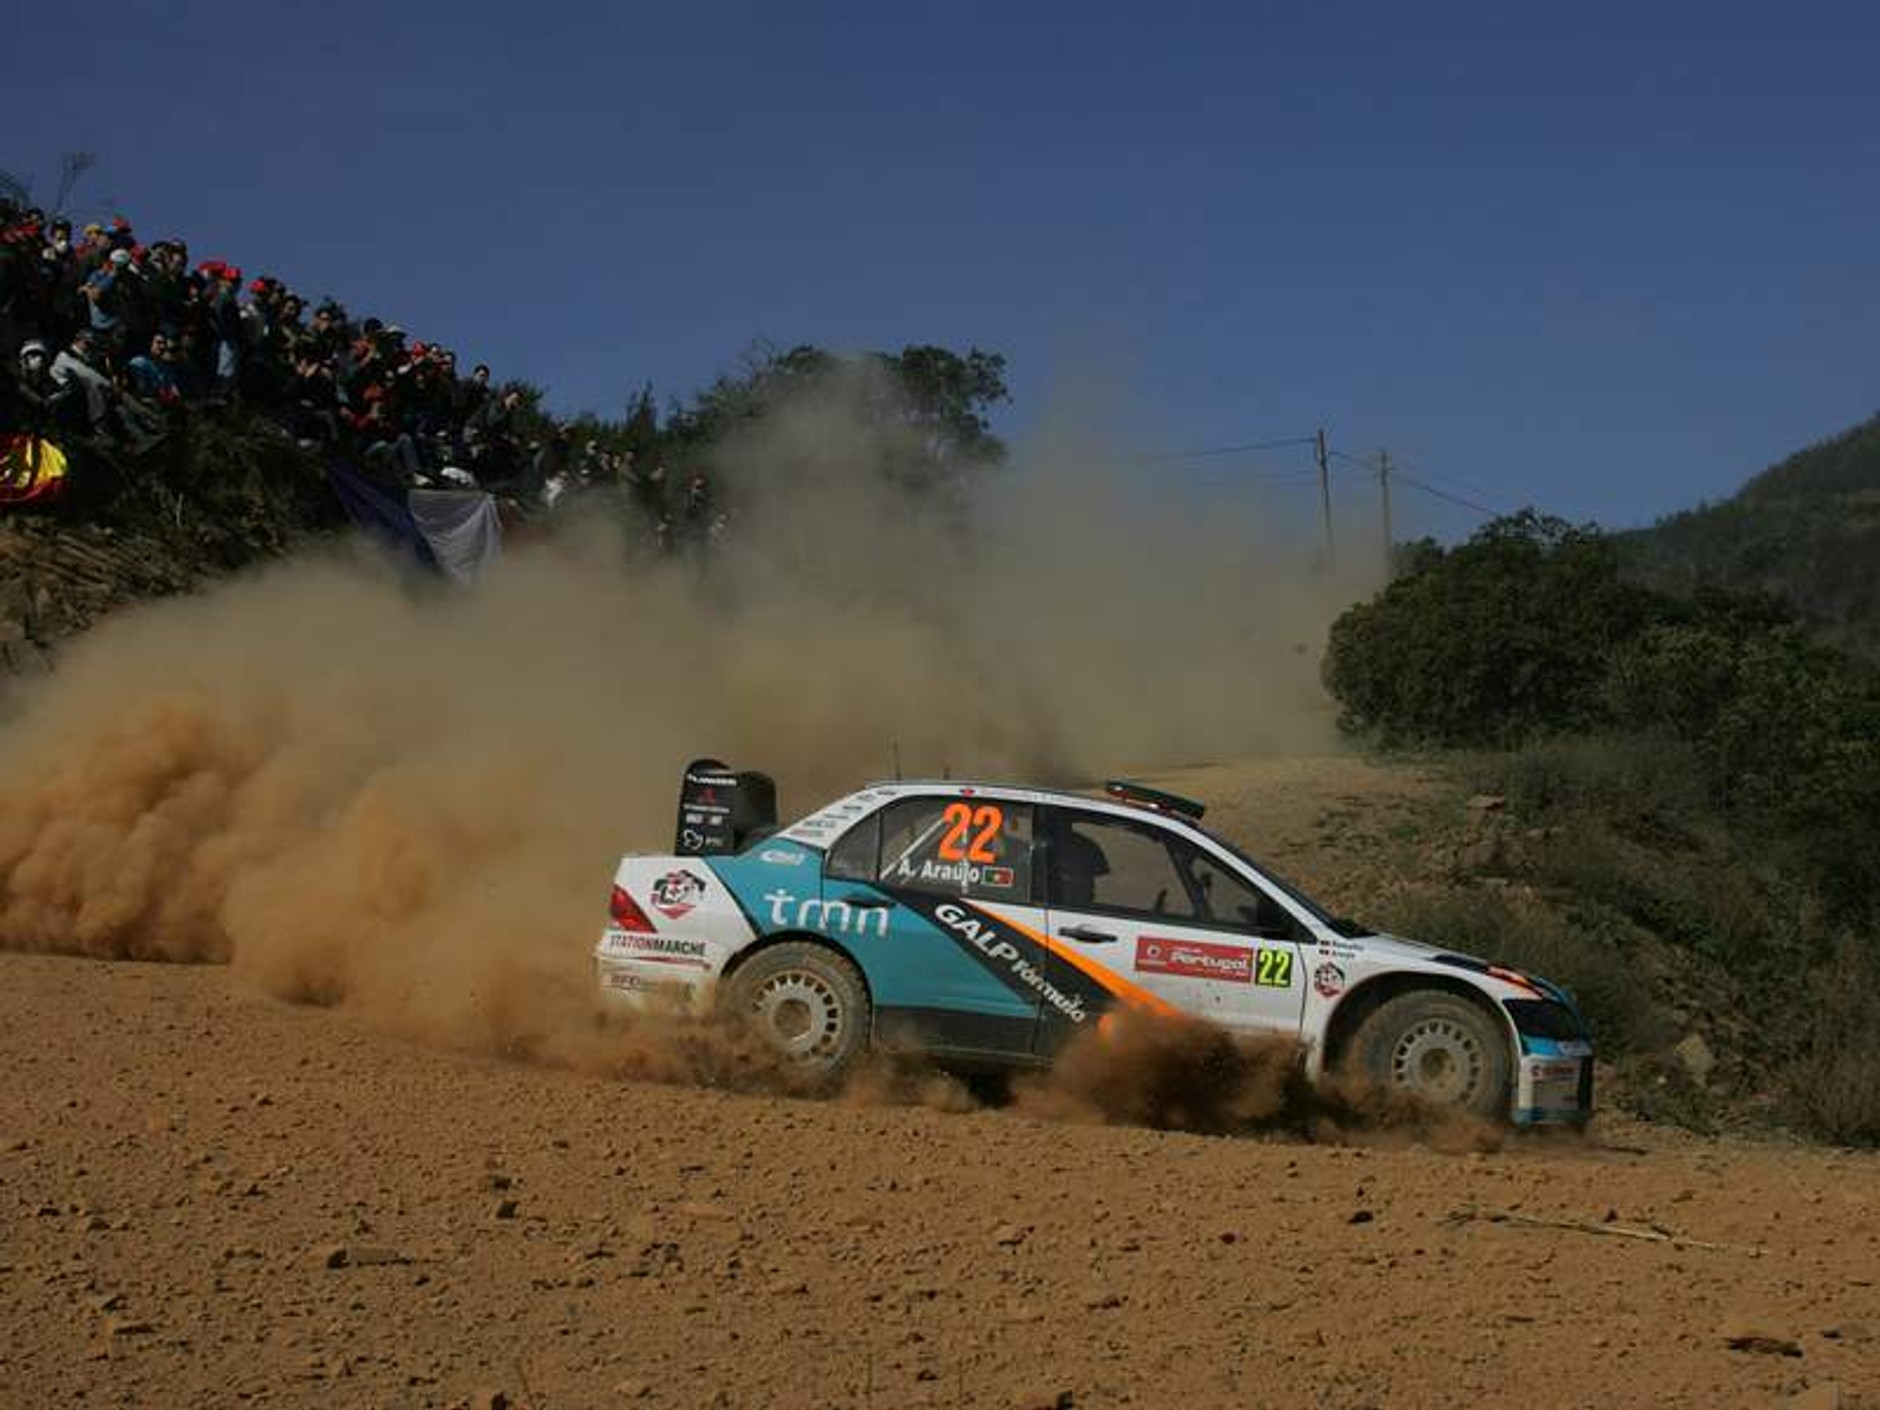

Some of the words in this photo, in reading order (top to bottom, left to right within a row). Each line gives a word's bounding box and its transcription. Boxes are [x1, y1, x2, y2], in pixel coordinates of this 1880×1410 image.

[939, 802, 1002, 863] 22
[898, 858, 916, 877] A.
[764, 889, 889, 937] tmn
[935, 904, 1020, 960] GALP
[1258, 951, 1290, 984] 22
